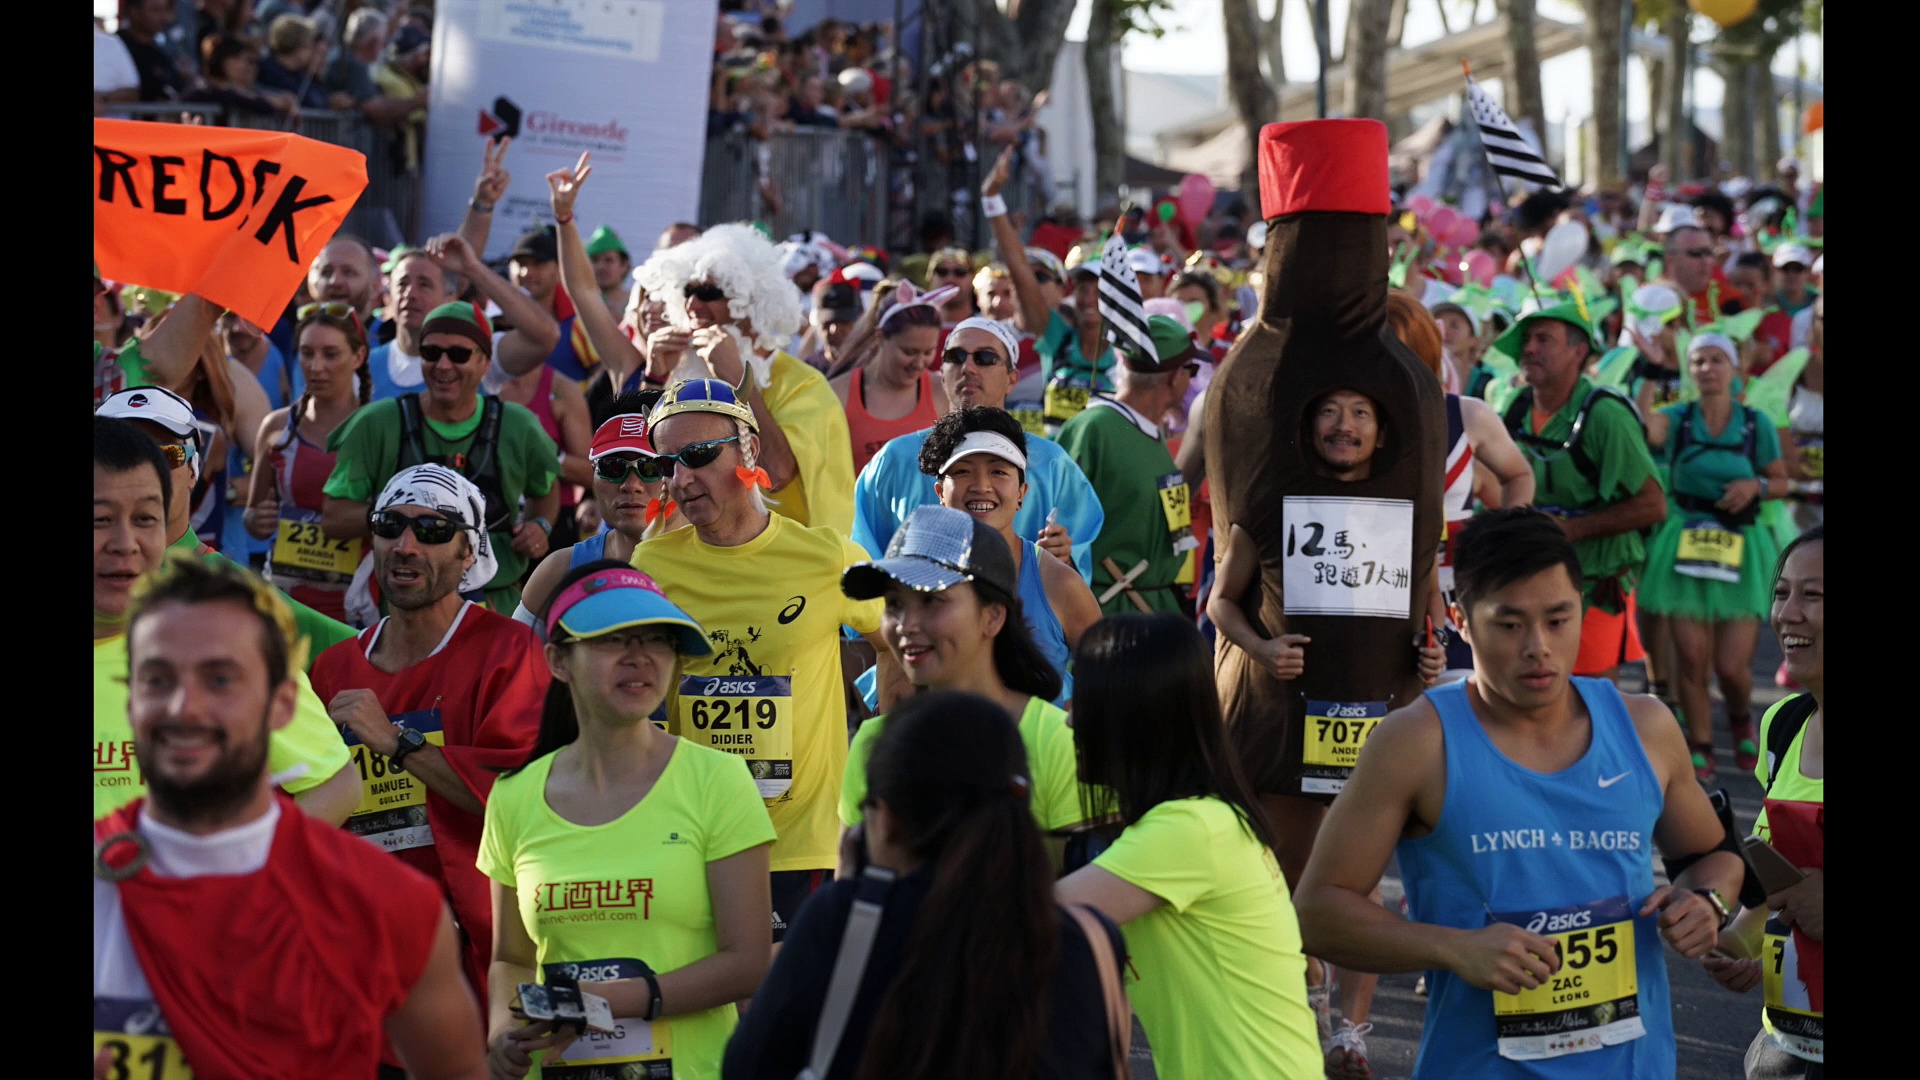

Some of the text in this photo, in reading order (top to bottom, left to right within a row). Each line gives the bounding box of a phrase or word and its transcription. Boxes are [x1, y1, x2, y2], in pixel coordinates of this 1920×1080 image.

[525, 110, 628, 142] Gironde
[720, 681, 757, 694] asics
[691, 699, 777, 730] 6219
[1338, 706, 1367, 717] asics
[711, 734, 753, 745] DIDIER
[370, 777, 414, 796] MANUEL
[379, 792, 411, 806] GUILLET
[1471, 829, 1641, 854] LYNCH BAGES
[534, 878, 655, 921] 红酒世界
[1547, 910, 1592, 932] asics
[579, 964, 621, 982] asics
[1552, 975, 1583, 992] ZAC
[1552, 990, 1591, 1005] LEONG
[102, 1040, 188, 1080] 31
